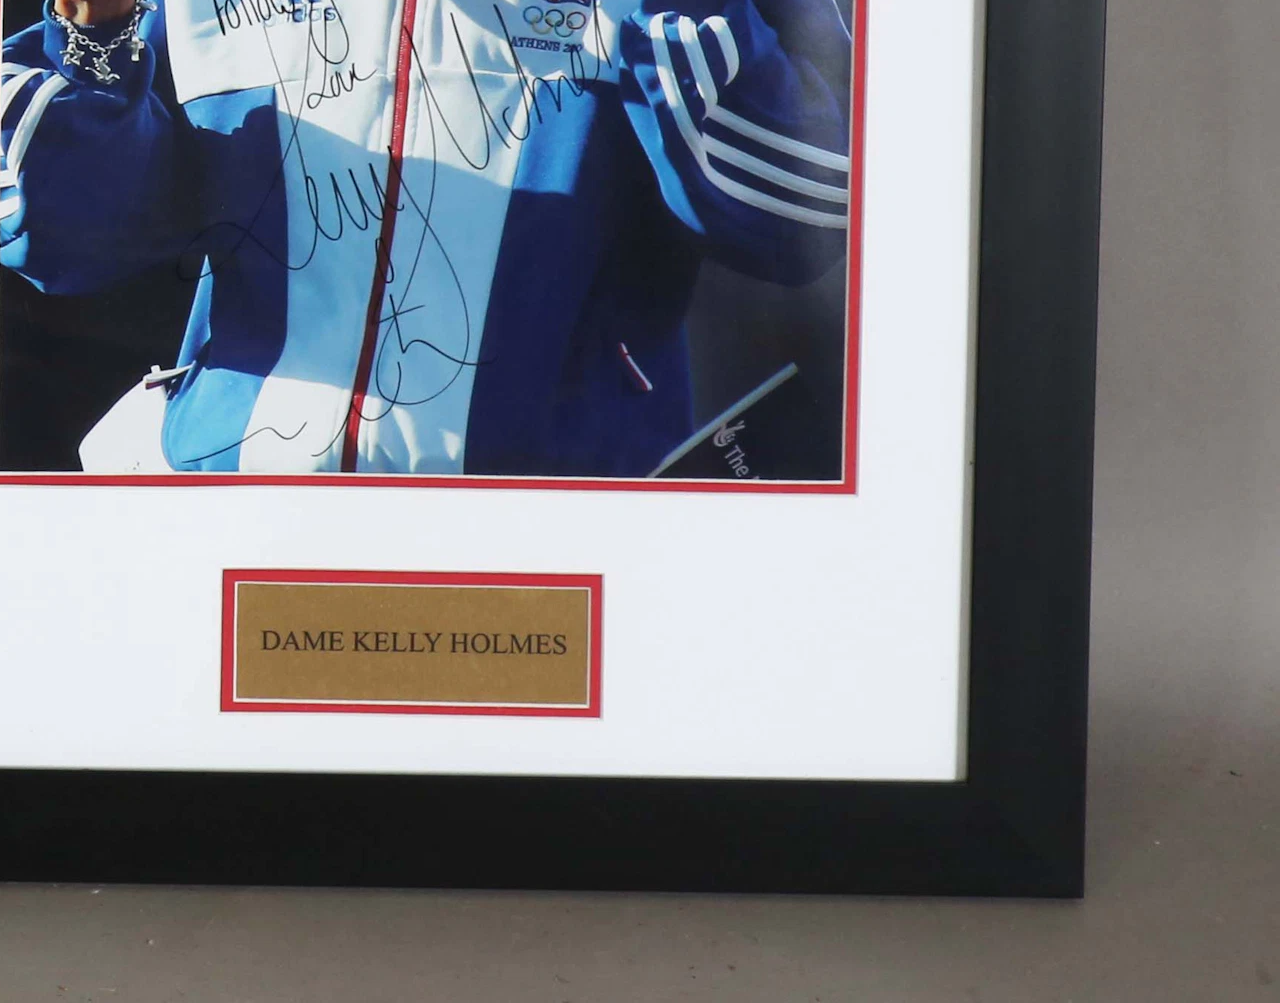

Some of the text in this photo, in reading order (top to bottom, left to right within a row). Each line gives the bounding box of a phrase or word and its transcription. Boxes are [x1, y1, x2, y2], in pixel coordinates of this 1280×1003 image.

[510, 36, 560, 52] ATHENS
[724, 445, 750, 478] The
[260, 630, 568, 656] DAME KELLY HOLMES
